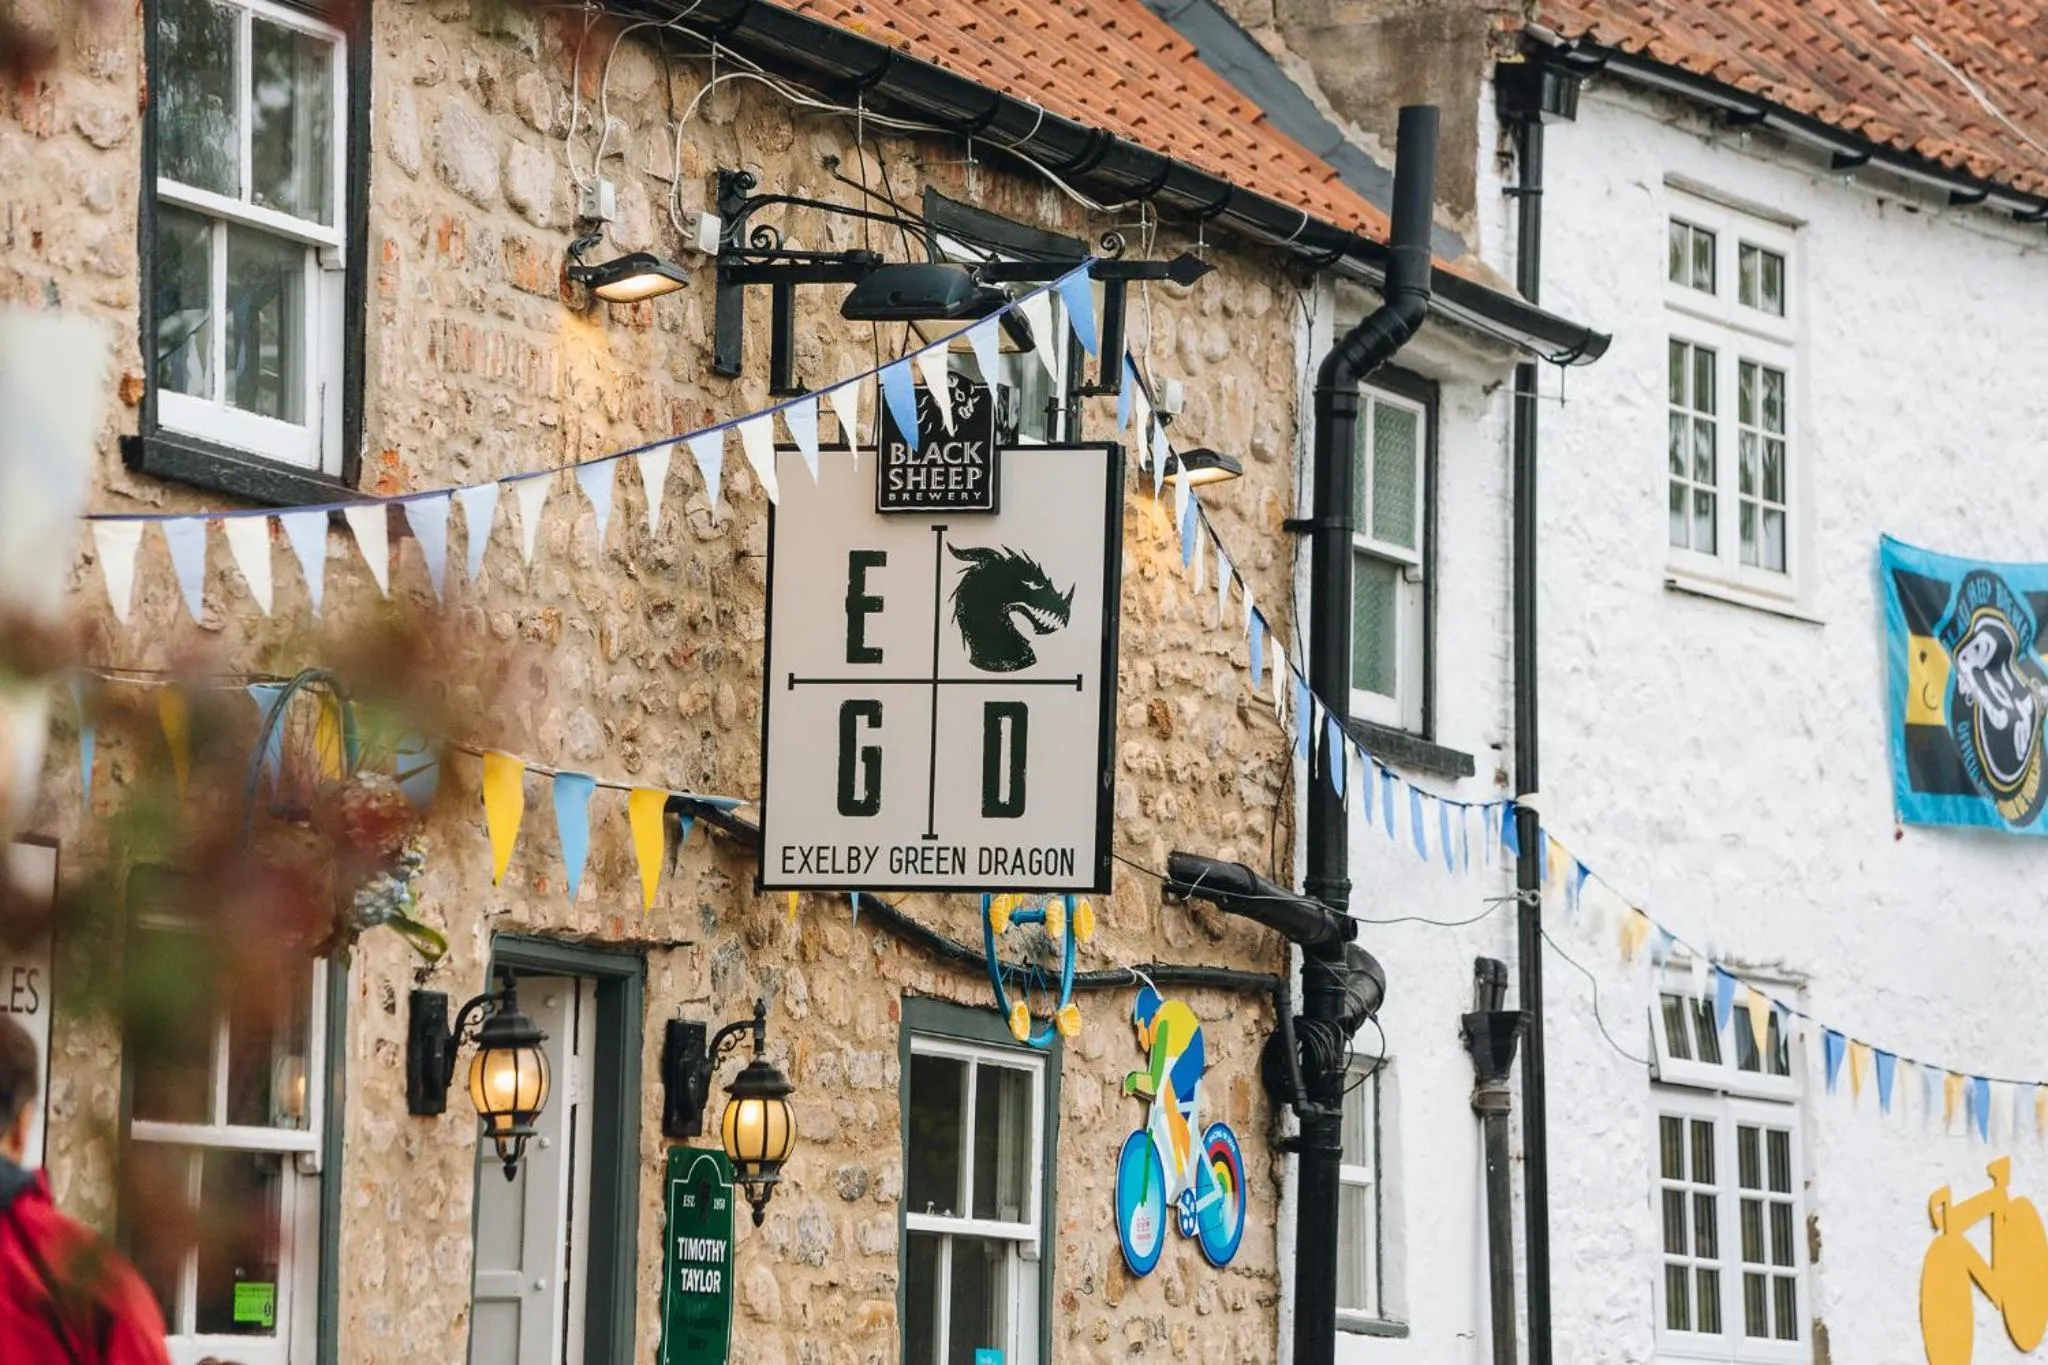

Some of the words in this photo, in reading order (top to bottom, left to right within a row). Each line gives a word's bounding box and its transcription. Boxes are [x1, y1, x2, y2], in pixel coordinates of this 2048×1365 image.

[890, 441, 984, 465] BLACK
[889, 467, 983, 491] SHEEP
[888, 492, 982, 501] BREWERY
[845, 550, 887, 664] E
[837, 699, 883, 817] G
[982, 701, 1029, 818] D
[781, 846, 879, 874] EXELBY
[889, 847, 966, 875] GREEN
[978, 847, 1075, 877] DRAGON
[677, 1237, 726, 1263] TIMOTHY
[681, 1268, 721, 1293] TAYLOR
